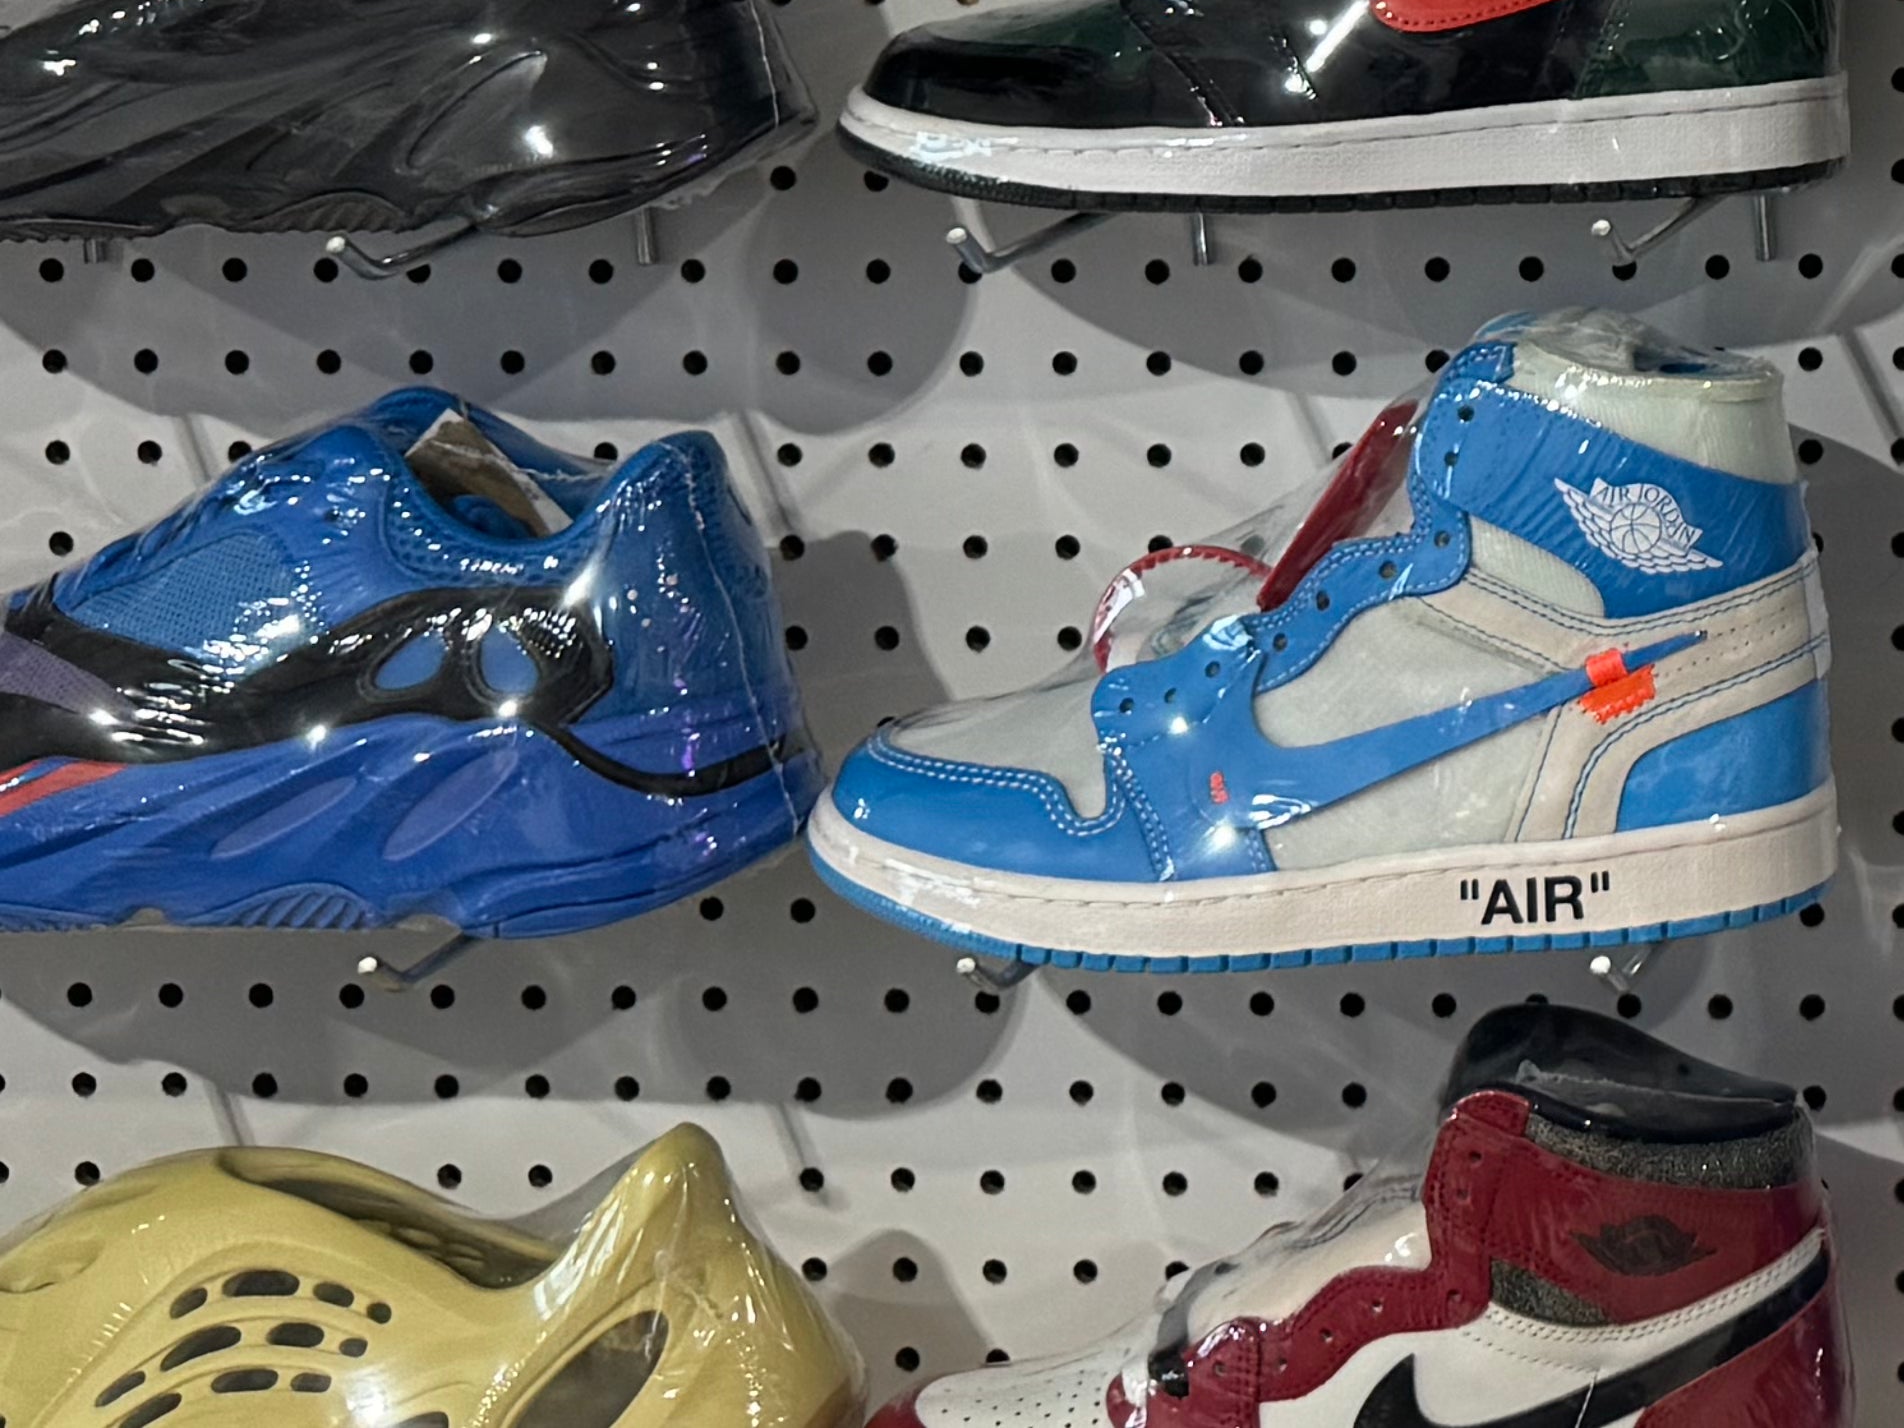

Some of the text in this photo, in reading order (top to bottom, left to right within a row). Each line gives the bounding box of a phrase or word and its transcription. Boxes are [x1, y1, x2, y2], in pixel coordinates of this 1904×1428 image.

[1594, 483, 1698, 550] AIR JORDAN
[1459, 869, 1611, 925] "AIR"
